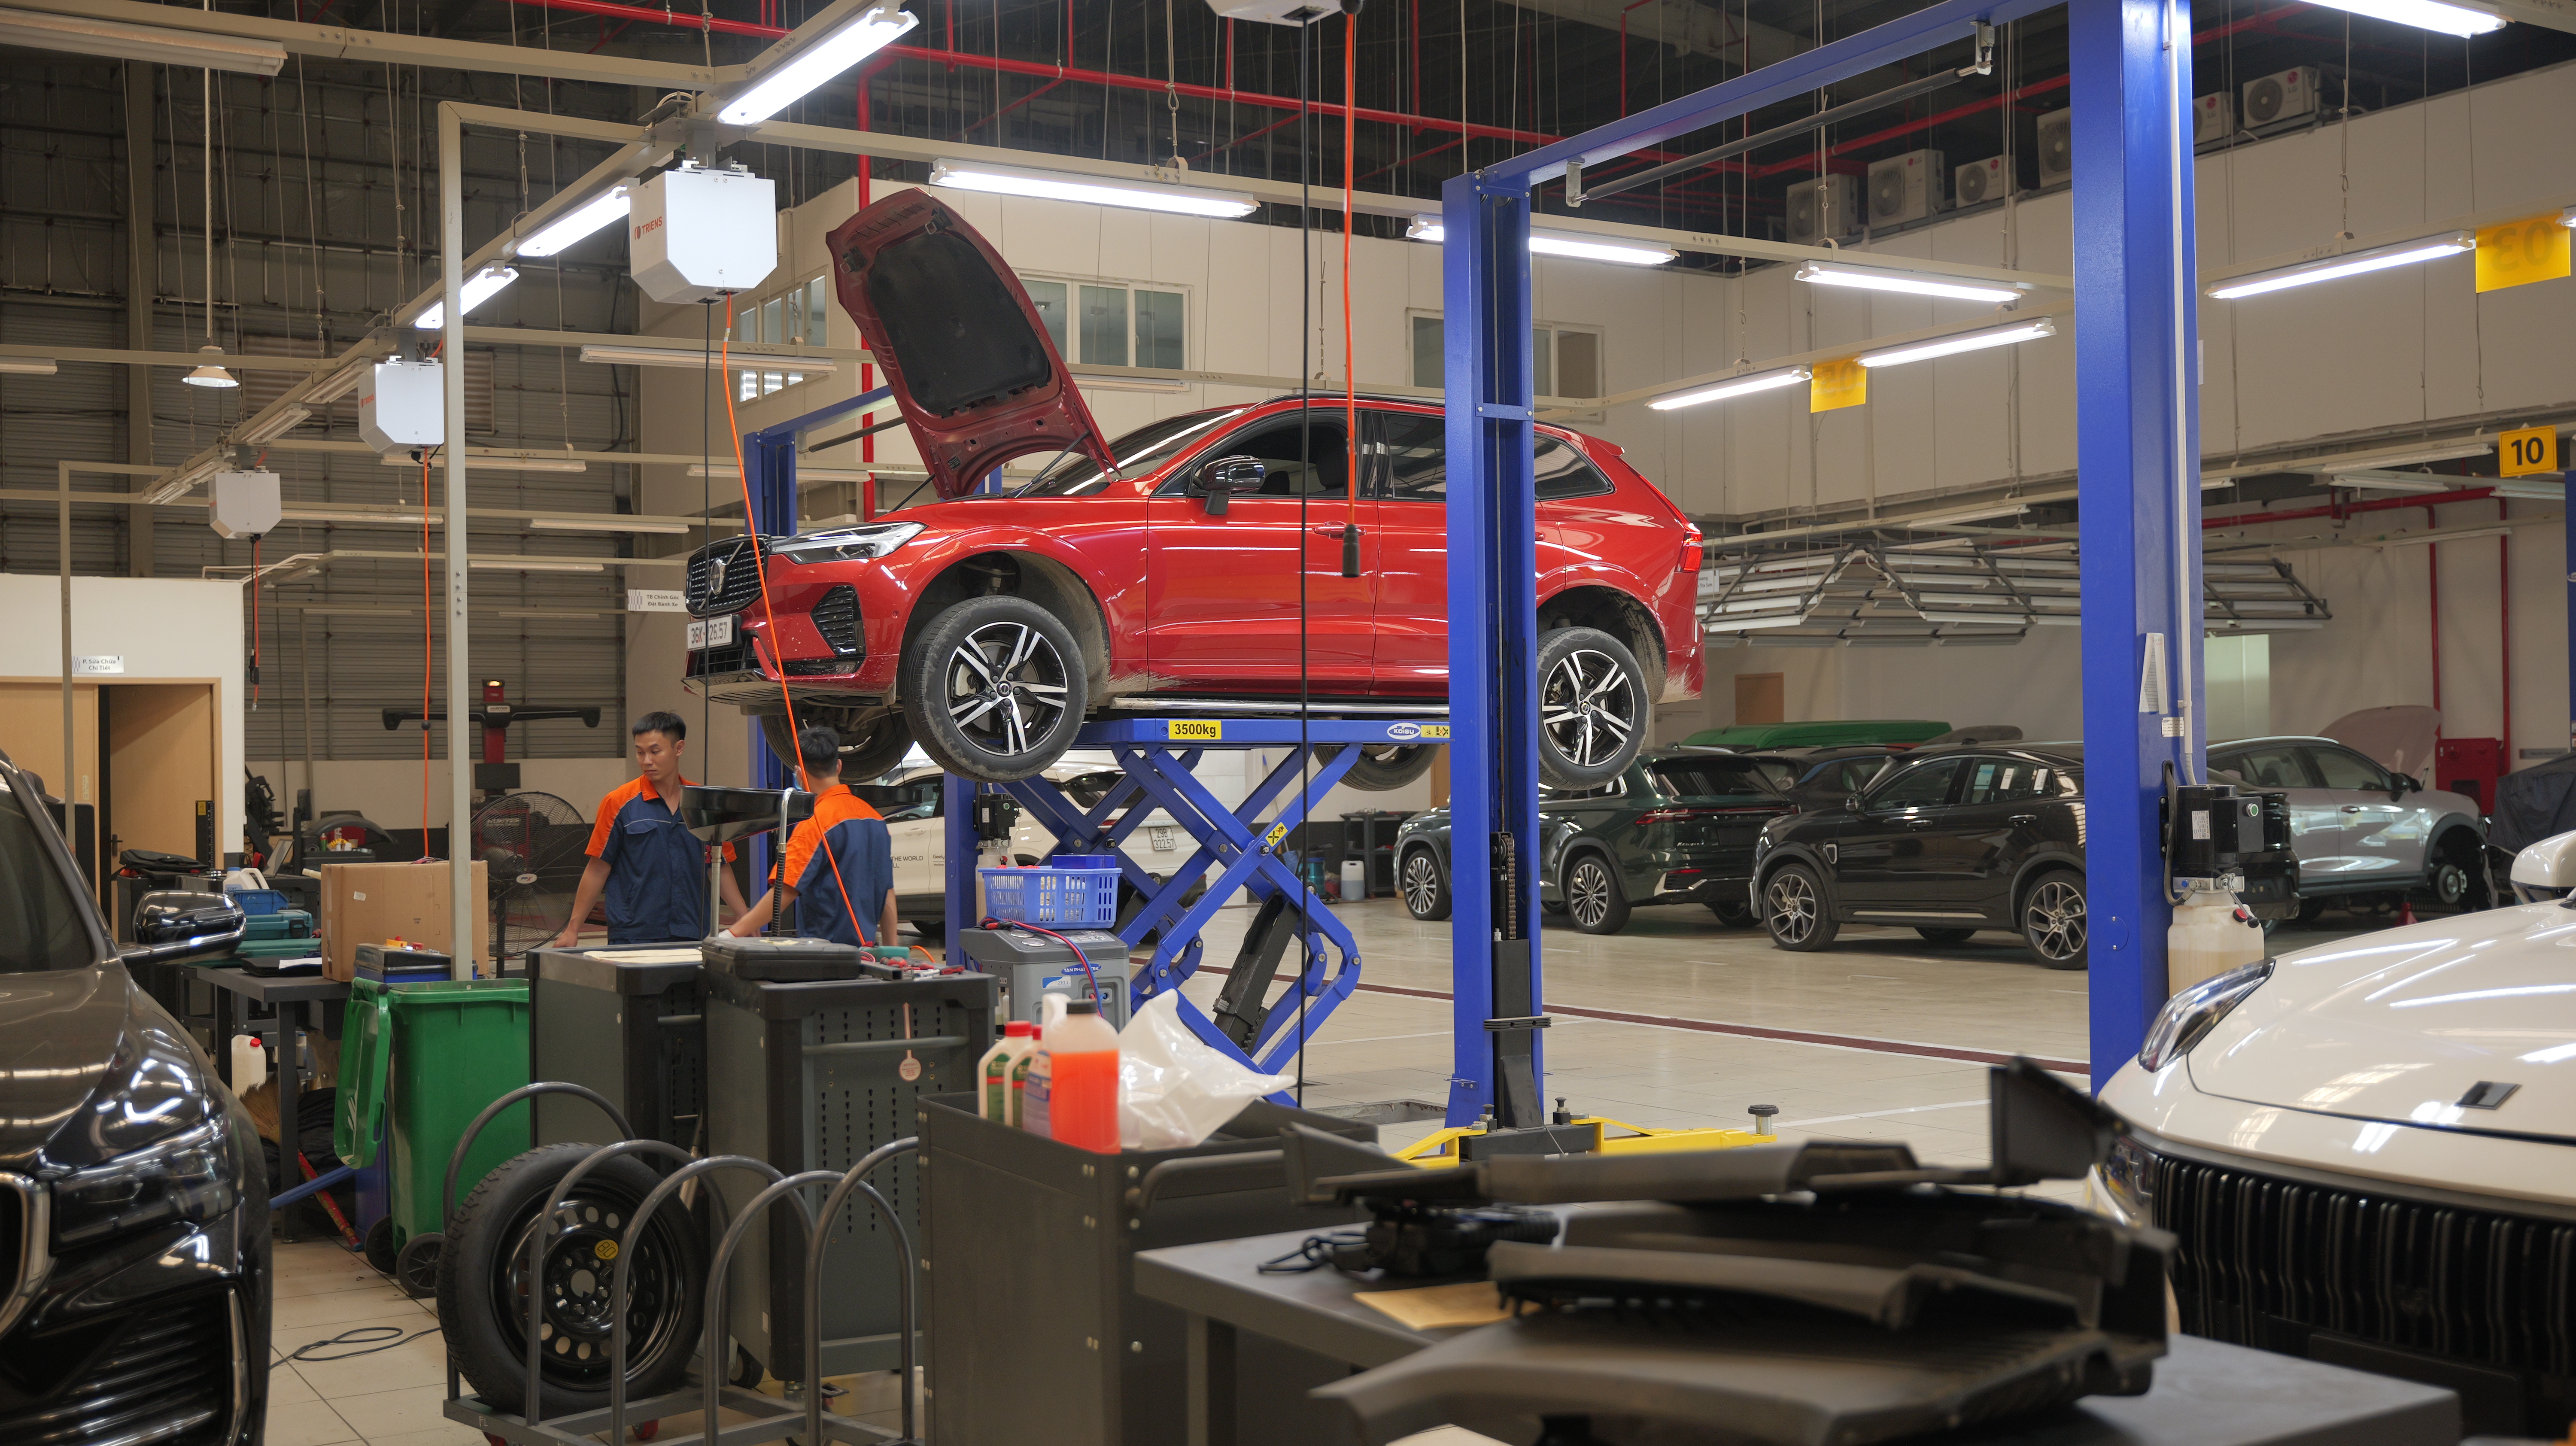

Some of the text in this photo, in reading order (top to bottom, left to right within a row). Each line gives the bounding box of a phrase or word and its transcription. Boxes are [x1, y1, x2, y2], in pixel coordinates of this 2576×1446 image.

[641, 216, 662, 235] TRIENS
[2511, 437, 2544, 466] 10
[1174, 723, 1216, 737] 3500kg
[1155, 828, 1168, 838] 29B
[479, 1416, 489, 1427] FL
